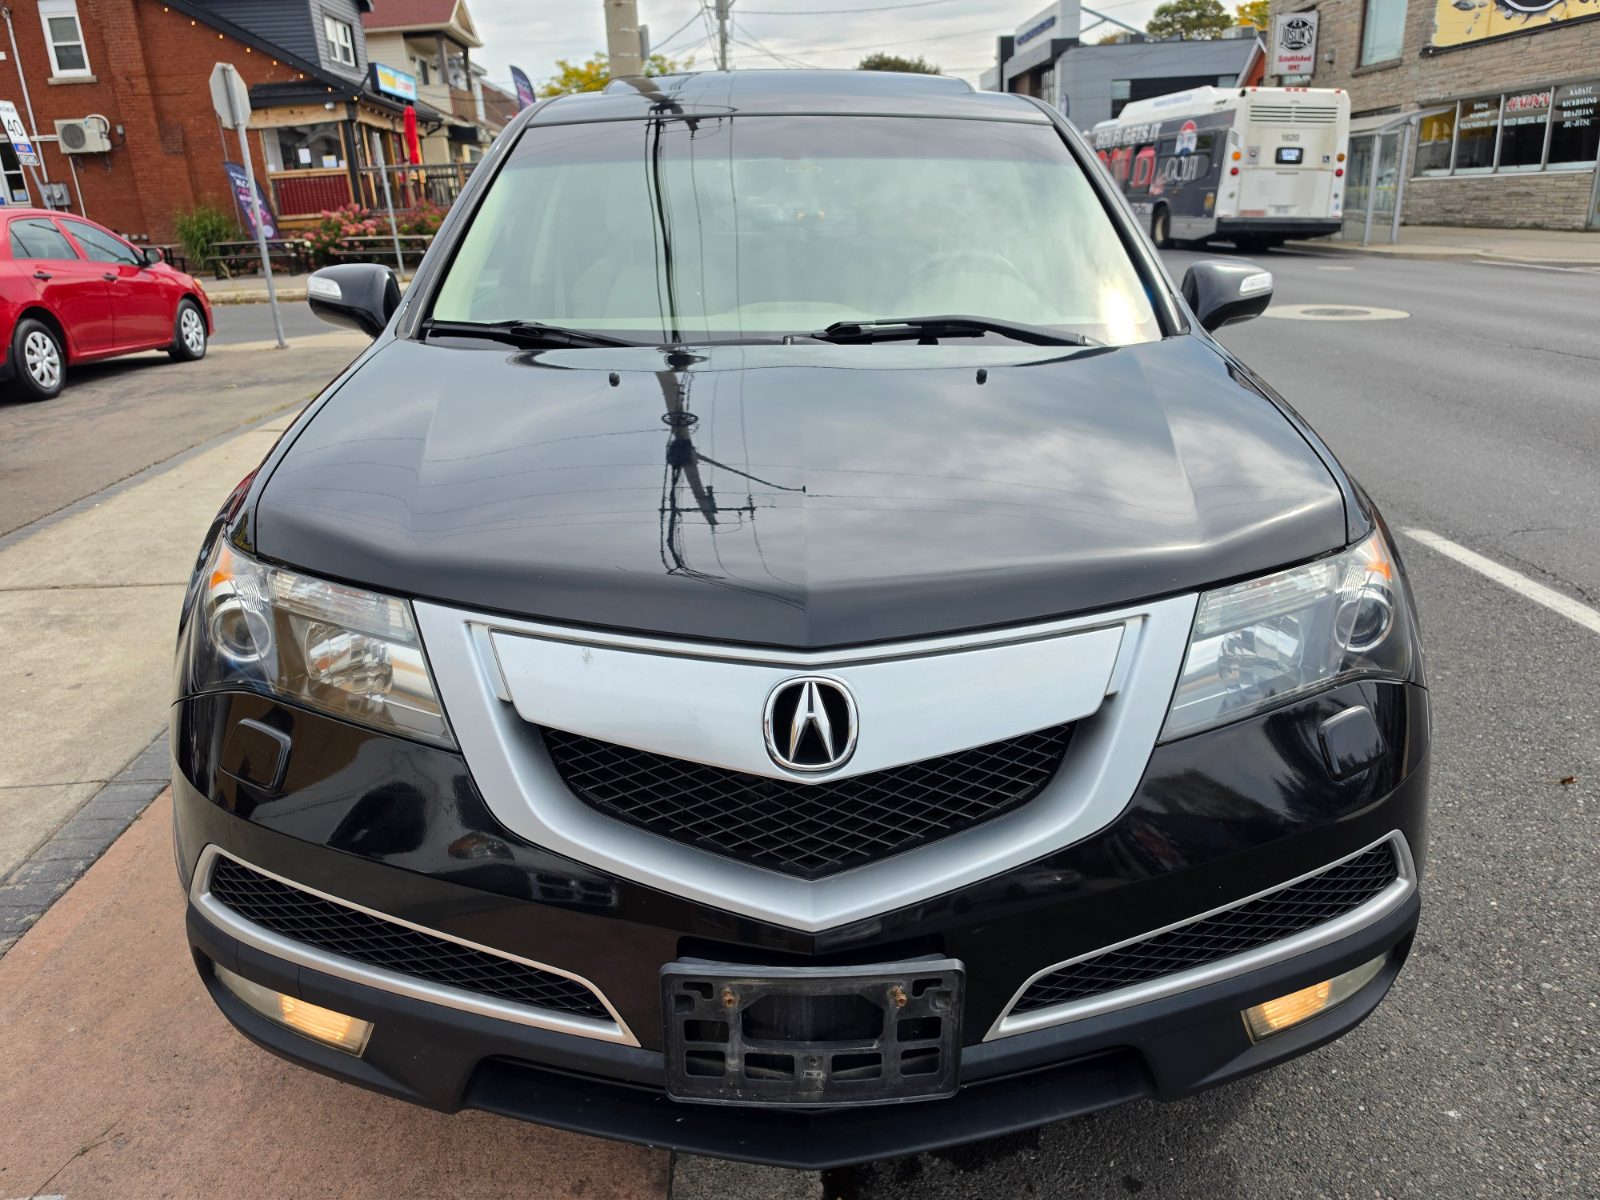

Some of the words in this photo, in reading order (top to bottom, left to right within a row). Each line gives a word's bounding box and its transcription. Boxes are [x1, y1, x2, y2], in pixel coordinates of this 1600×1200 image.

[1570, 87, 1592, 96] KARATE
[1562, 97, 1598, 107] KICKBOXING
[1563, 109, 1593, 118] BRAZILIAN
[1517, 115, 1536, 125] MARTIAL
[7, 119, 24, 136] 40
[1282, 134, 1299, 142] 1620
